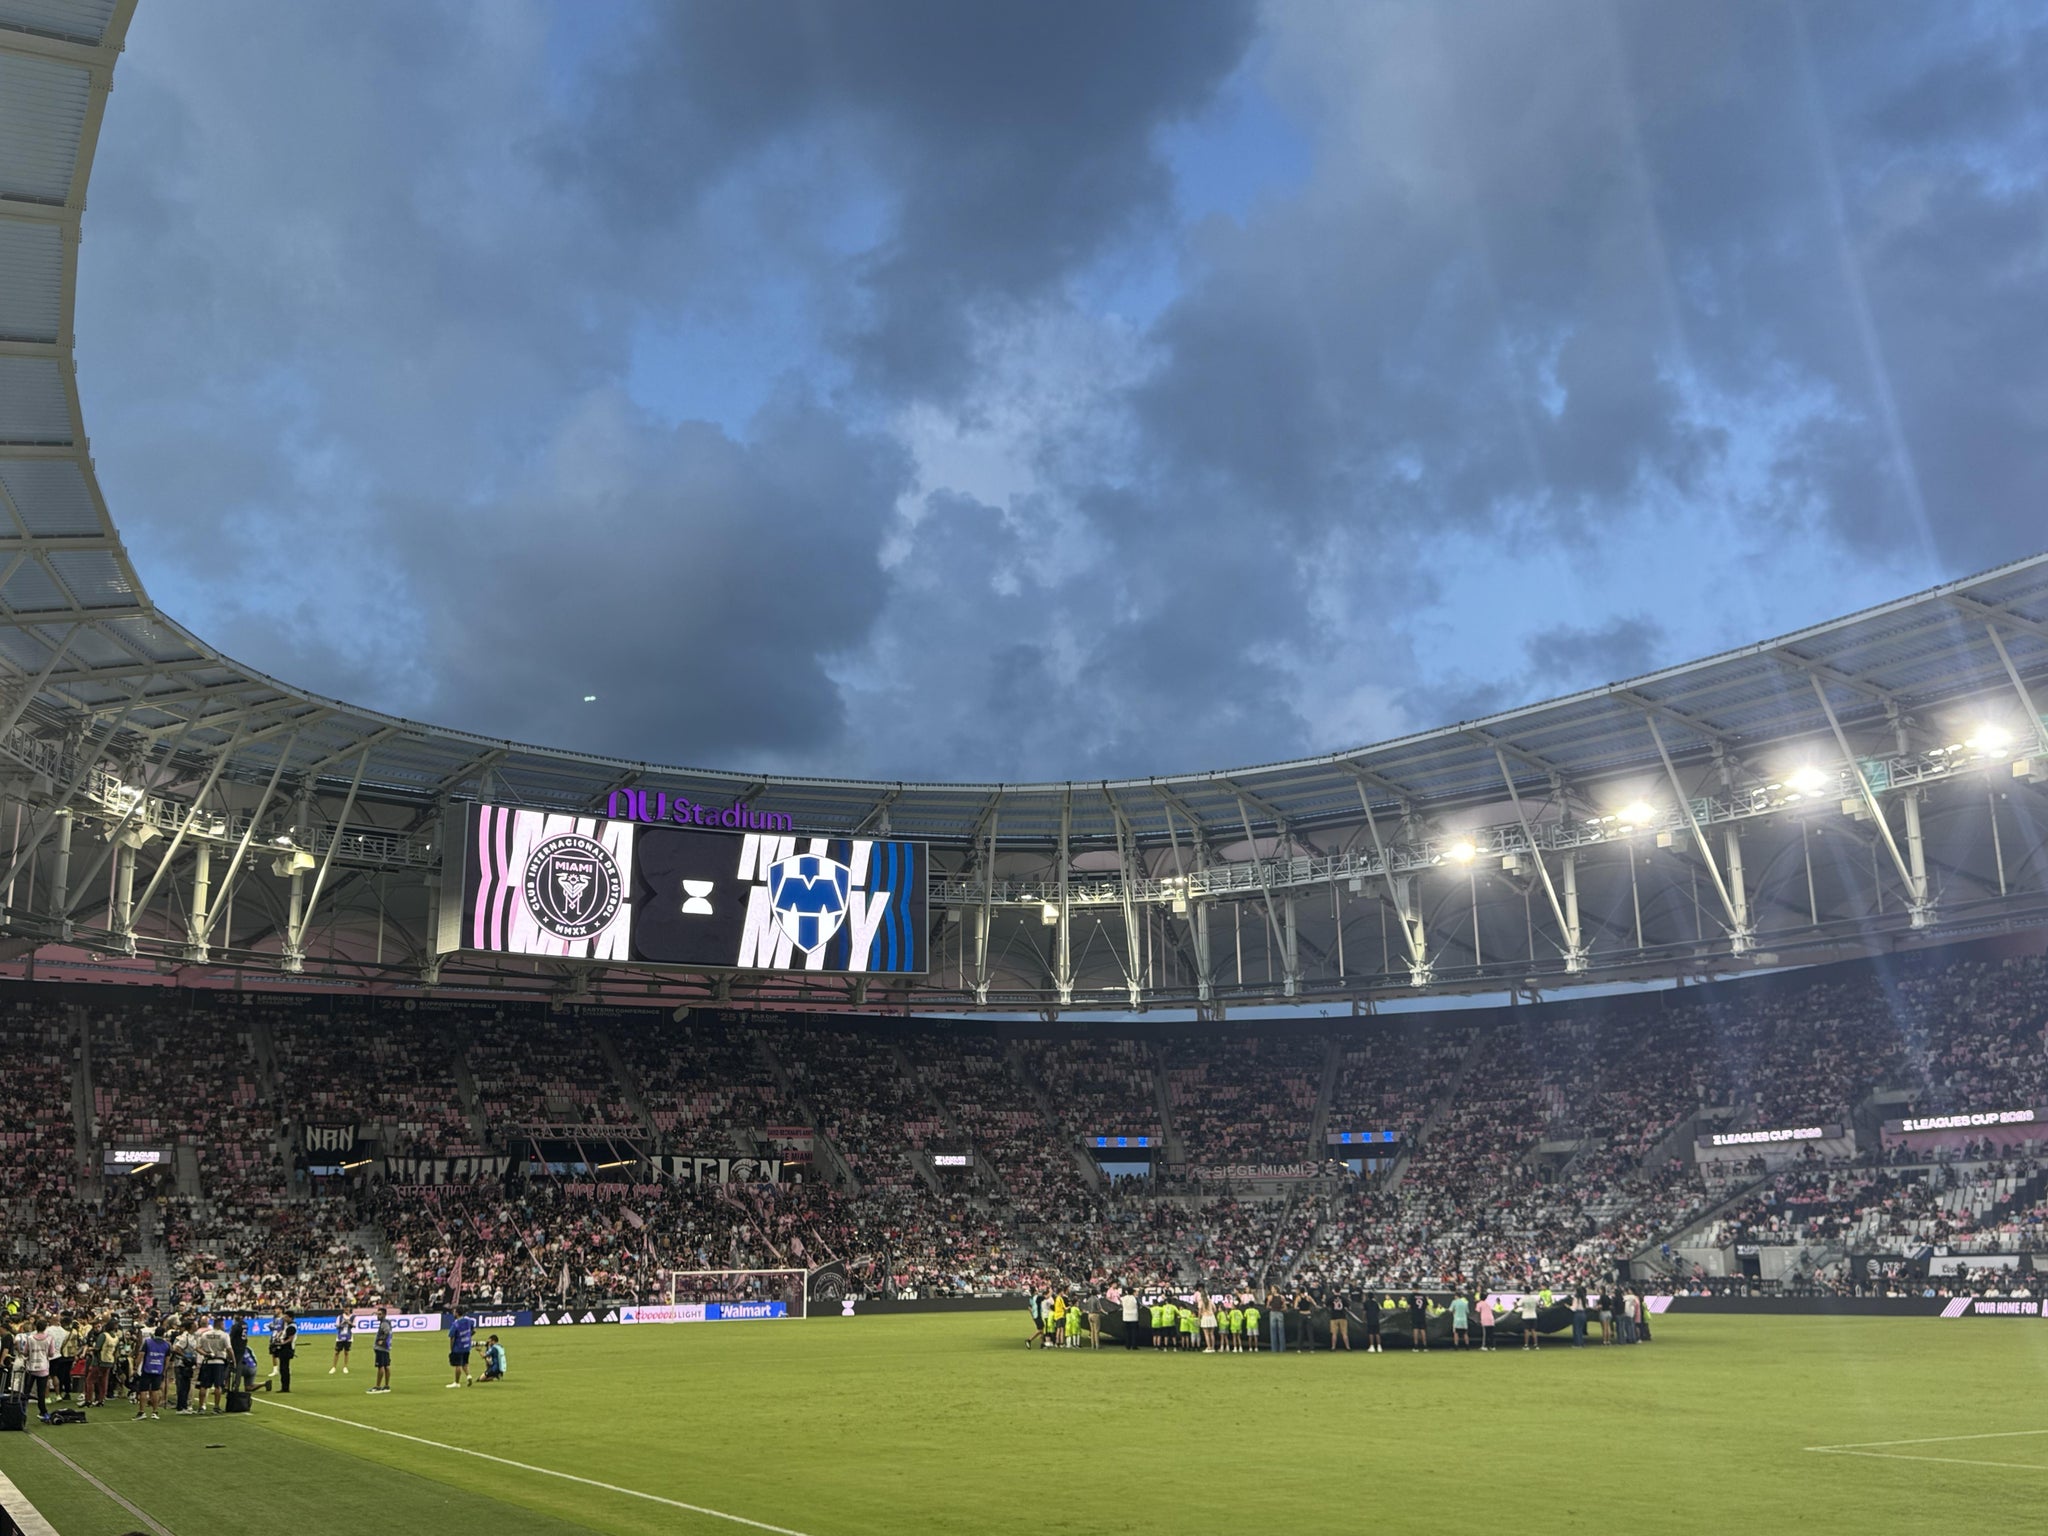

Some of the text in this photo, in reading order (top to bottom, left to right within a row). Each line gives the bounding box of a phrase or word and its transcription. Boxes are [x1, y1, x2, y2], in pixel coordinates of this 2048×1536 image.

[673, 798, 793, 831] Stadium
[528, 839, 604, 877] INTERNACIONAL
[555, 861, 593, 873] MIAMI
[604, 861, 616, 875] DE
[527, 883, 540, 911] CLUB
[555, 925, 587, 935] MMXX
[1913, 1115, 1971, 1130] LEAGUES
[1971, 1112, 1999, 1125] CUP
[1722, 1131, 1769, 1145] LEAGUES
[1770, 1130, 1793, 1141] CUP
[791, 1151, 813, 1161] MIAMI
[1213, 1164, 1304, 1177] SIEGE MIAMI
[721, 1304, 771, 1318] Walmart
[1333, 1300, 1343, 1310] 10
[1415, 1300, 1424, 1310] 9
[1974, 1302, 1996, 1313] YOUR
[1997, 1302, 2020, 1314] HOME
[2021, 1303, 2038, 1314] FOR
[678, 1310, 701, 1319] LIGHT
[358, 1318, 410, 1329] GECO
